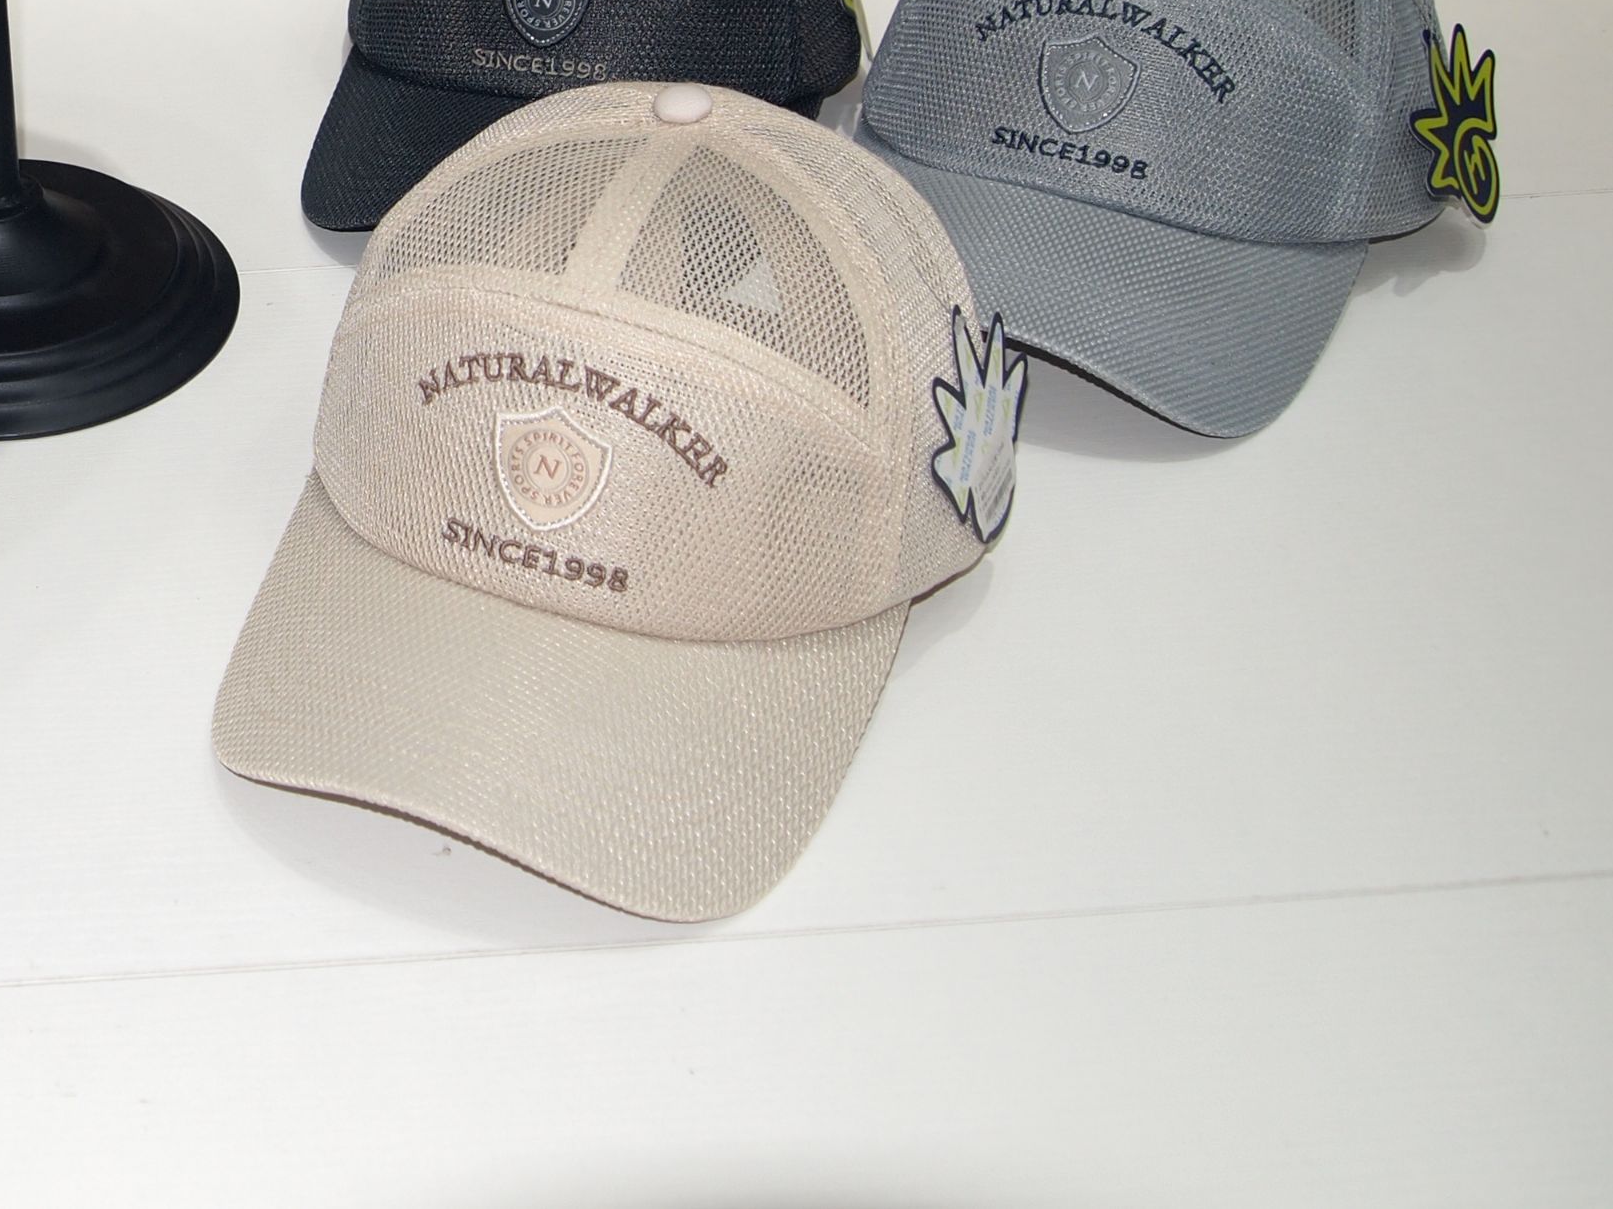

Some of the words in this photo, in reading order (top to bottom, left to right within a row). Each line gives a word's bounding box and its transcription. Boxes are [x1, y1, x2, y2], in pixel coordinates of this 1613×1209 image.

[471, 48, 608, 81] SINCE1998
[1074, 70, 1099, 90] N
[991, 126, 1148, 180] SINCE1998
[418, 351, 728, 488] NATURALWALKER
[524, 432, 572, 450] SPIRIT
[511, 446, 540, 500] SPORTS
[533, 454, 562, 480] N
[544, 452, 584, 504] FOREVER
[442, 517, 629, 592] SINCE1998
